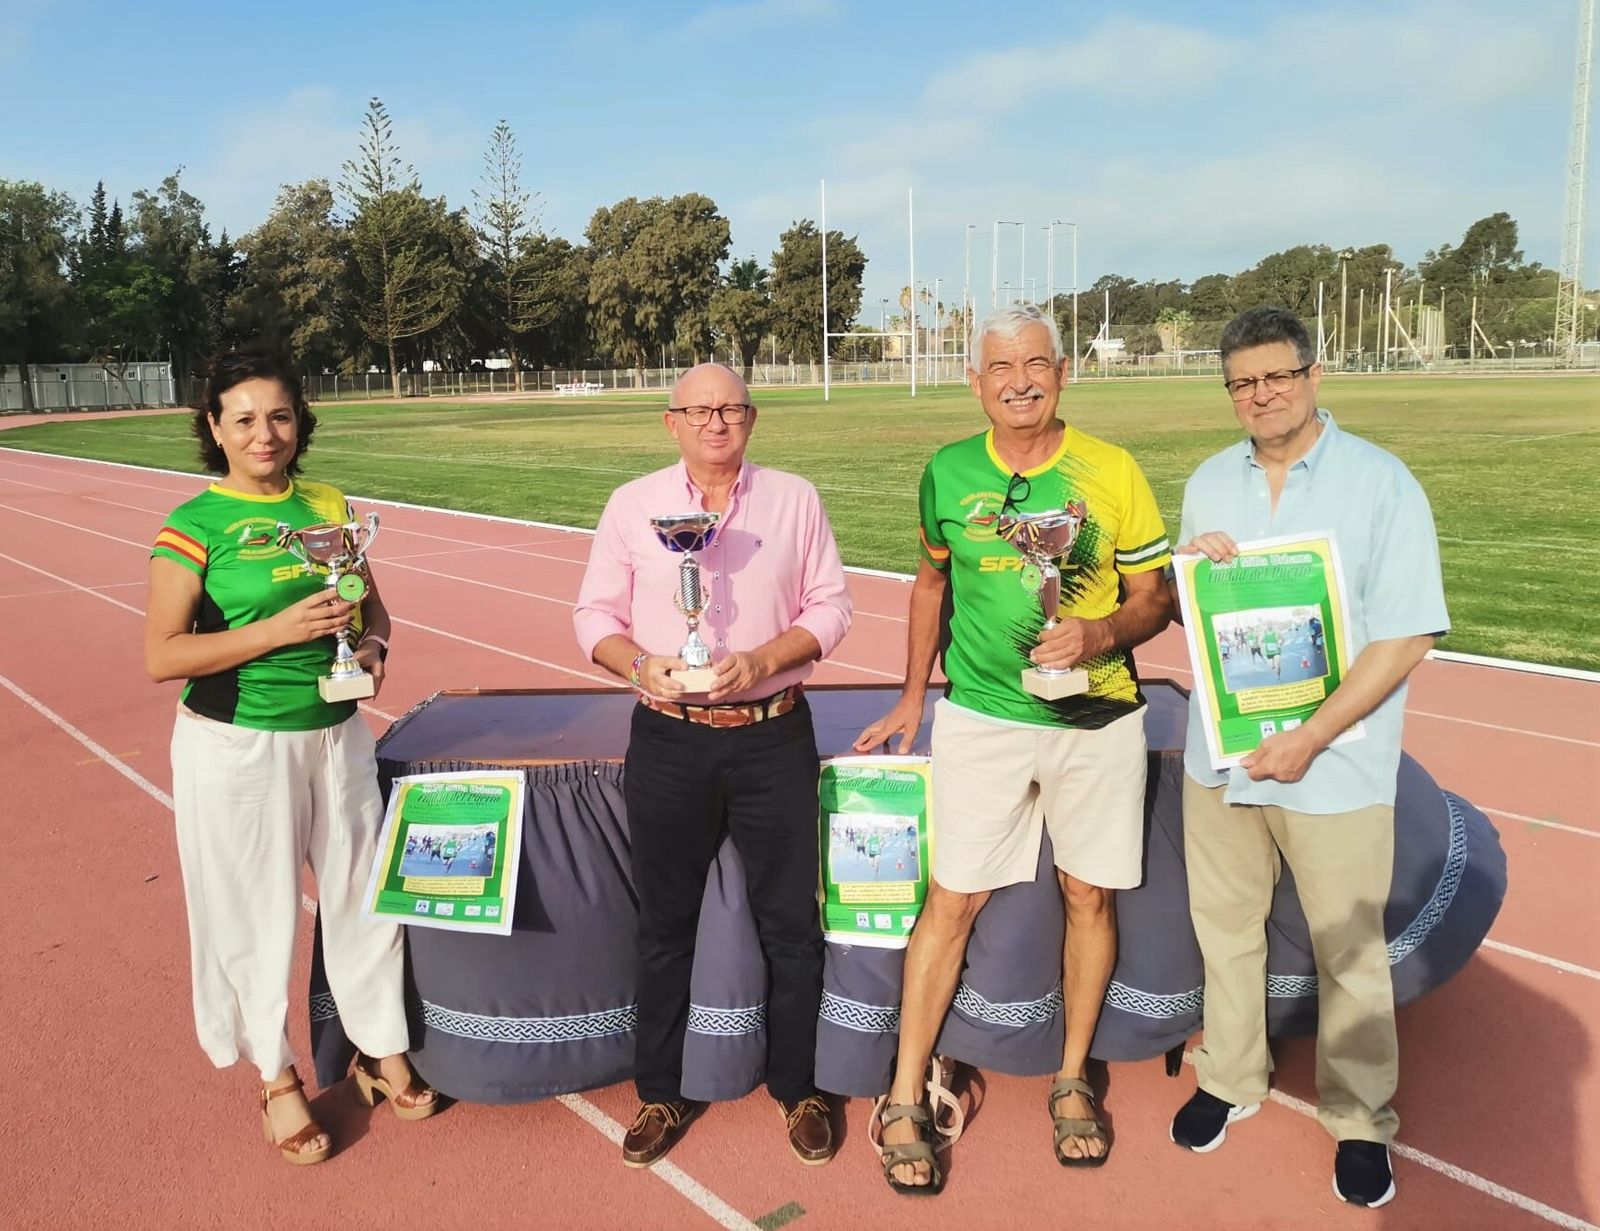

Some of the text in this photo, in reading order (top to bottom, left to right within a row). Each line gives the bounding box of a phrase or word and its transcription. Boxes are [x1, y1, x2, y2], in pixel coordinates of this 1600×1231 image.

[1269, 554, 1313, 566] Urbana
[1208, 569, 1246, 584] Ciudad
[1249, 567, 1269, 579] del
[1272, 565, 1313, 579] Puerto
